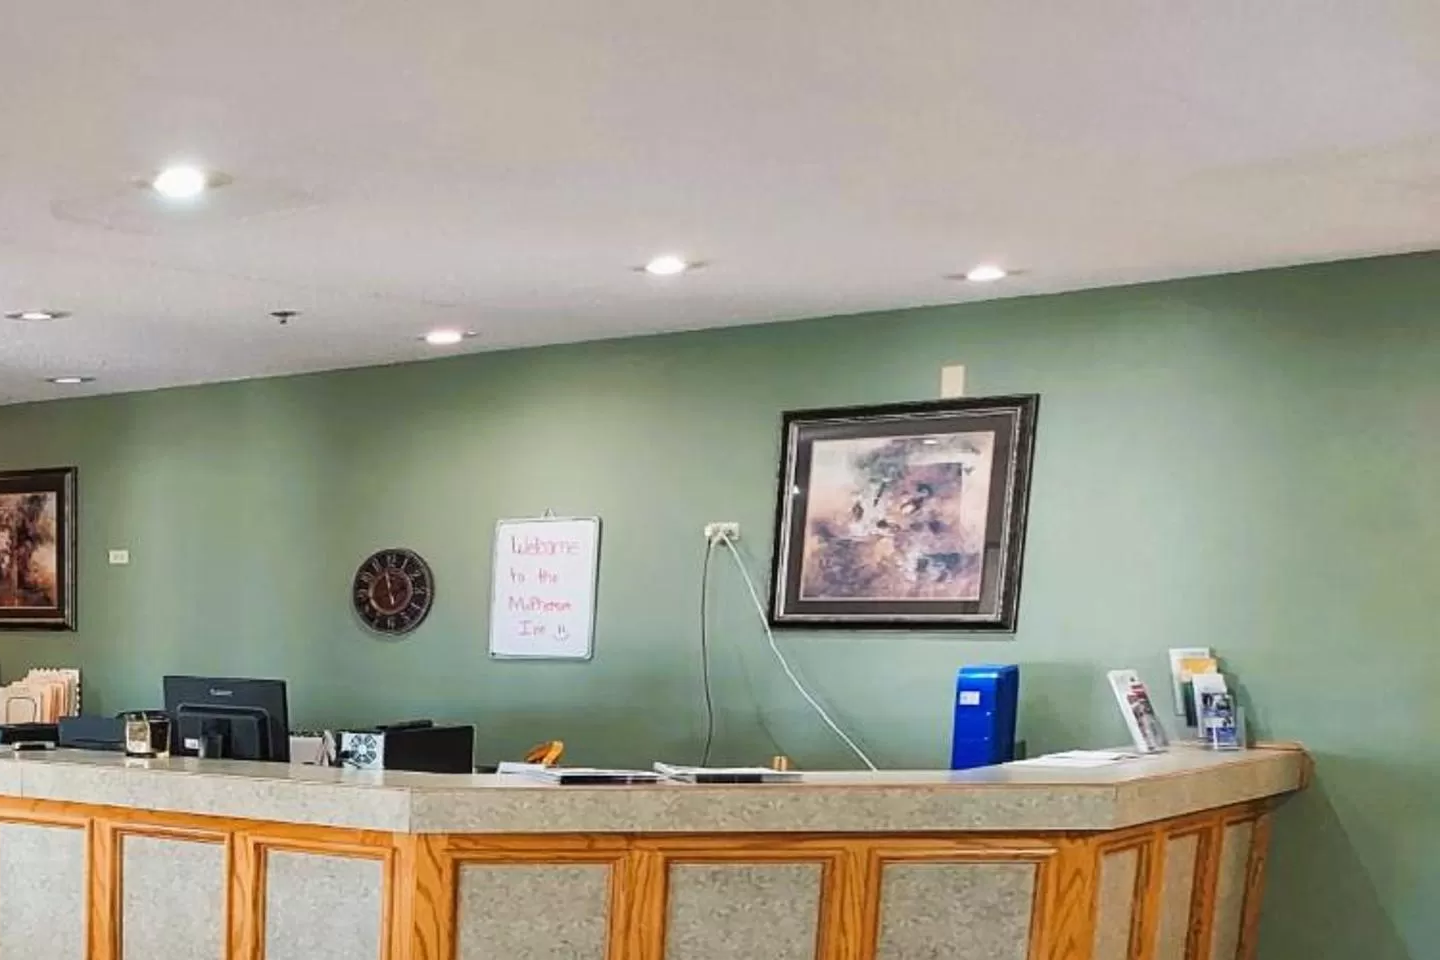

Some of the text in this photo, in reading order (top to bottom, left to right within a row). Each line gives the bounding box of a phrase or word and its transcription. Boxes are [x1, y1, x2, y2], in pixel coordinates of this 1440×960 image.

[510, 535, 580, 555] Welcome
[510, 567, 558, 584] to the
